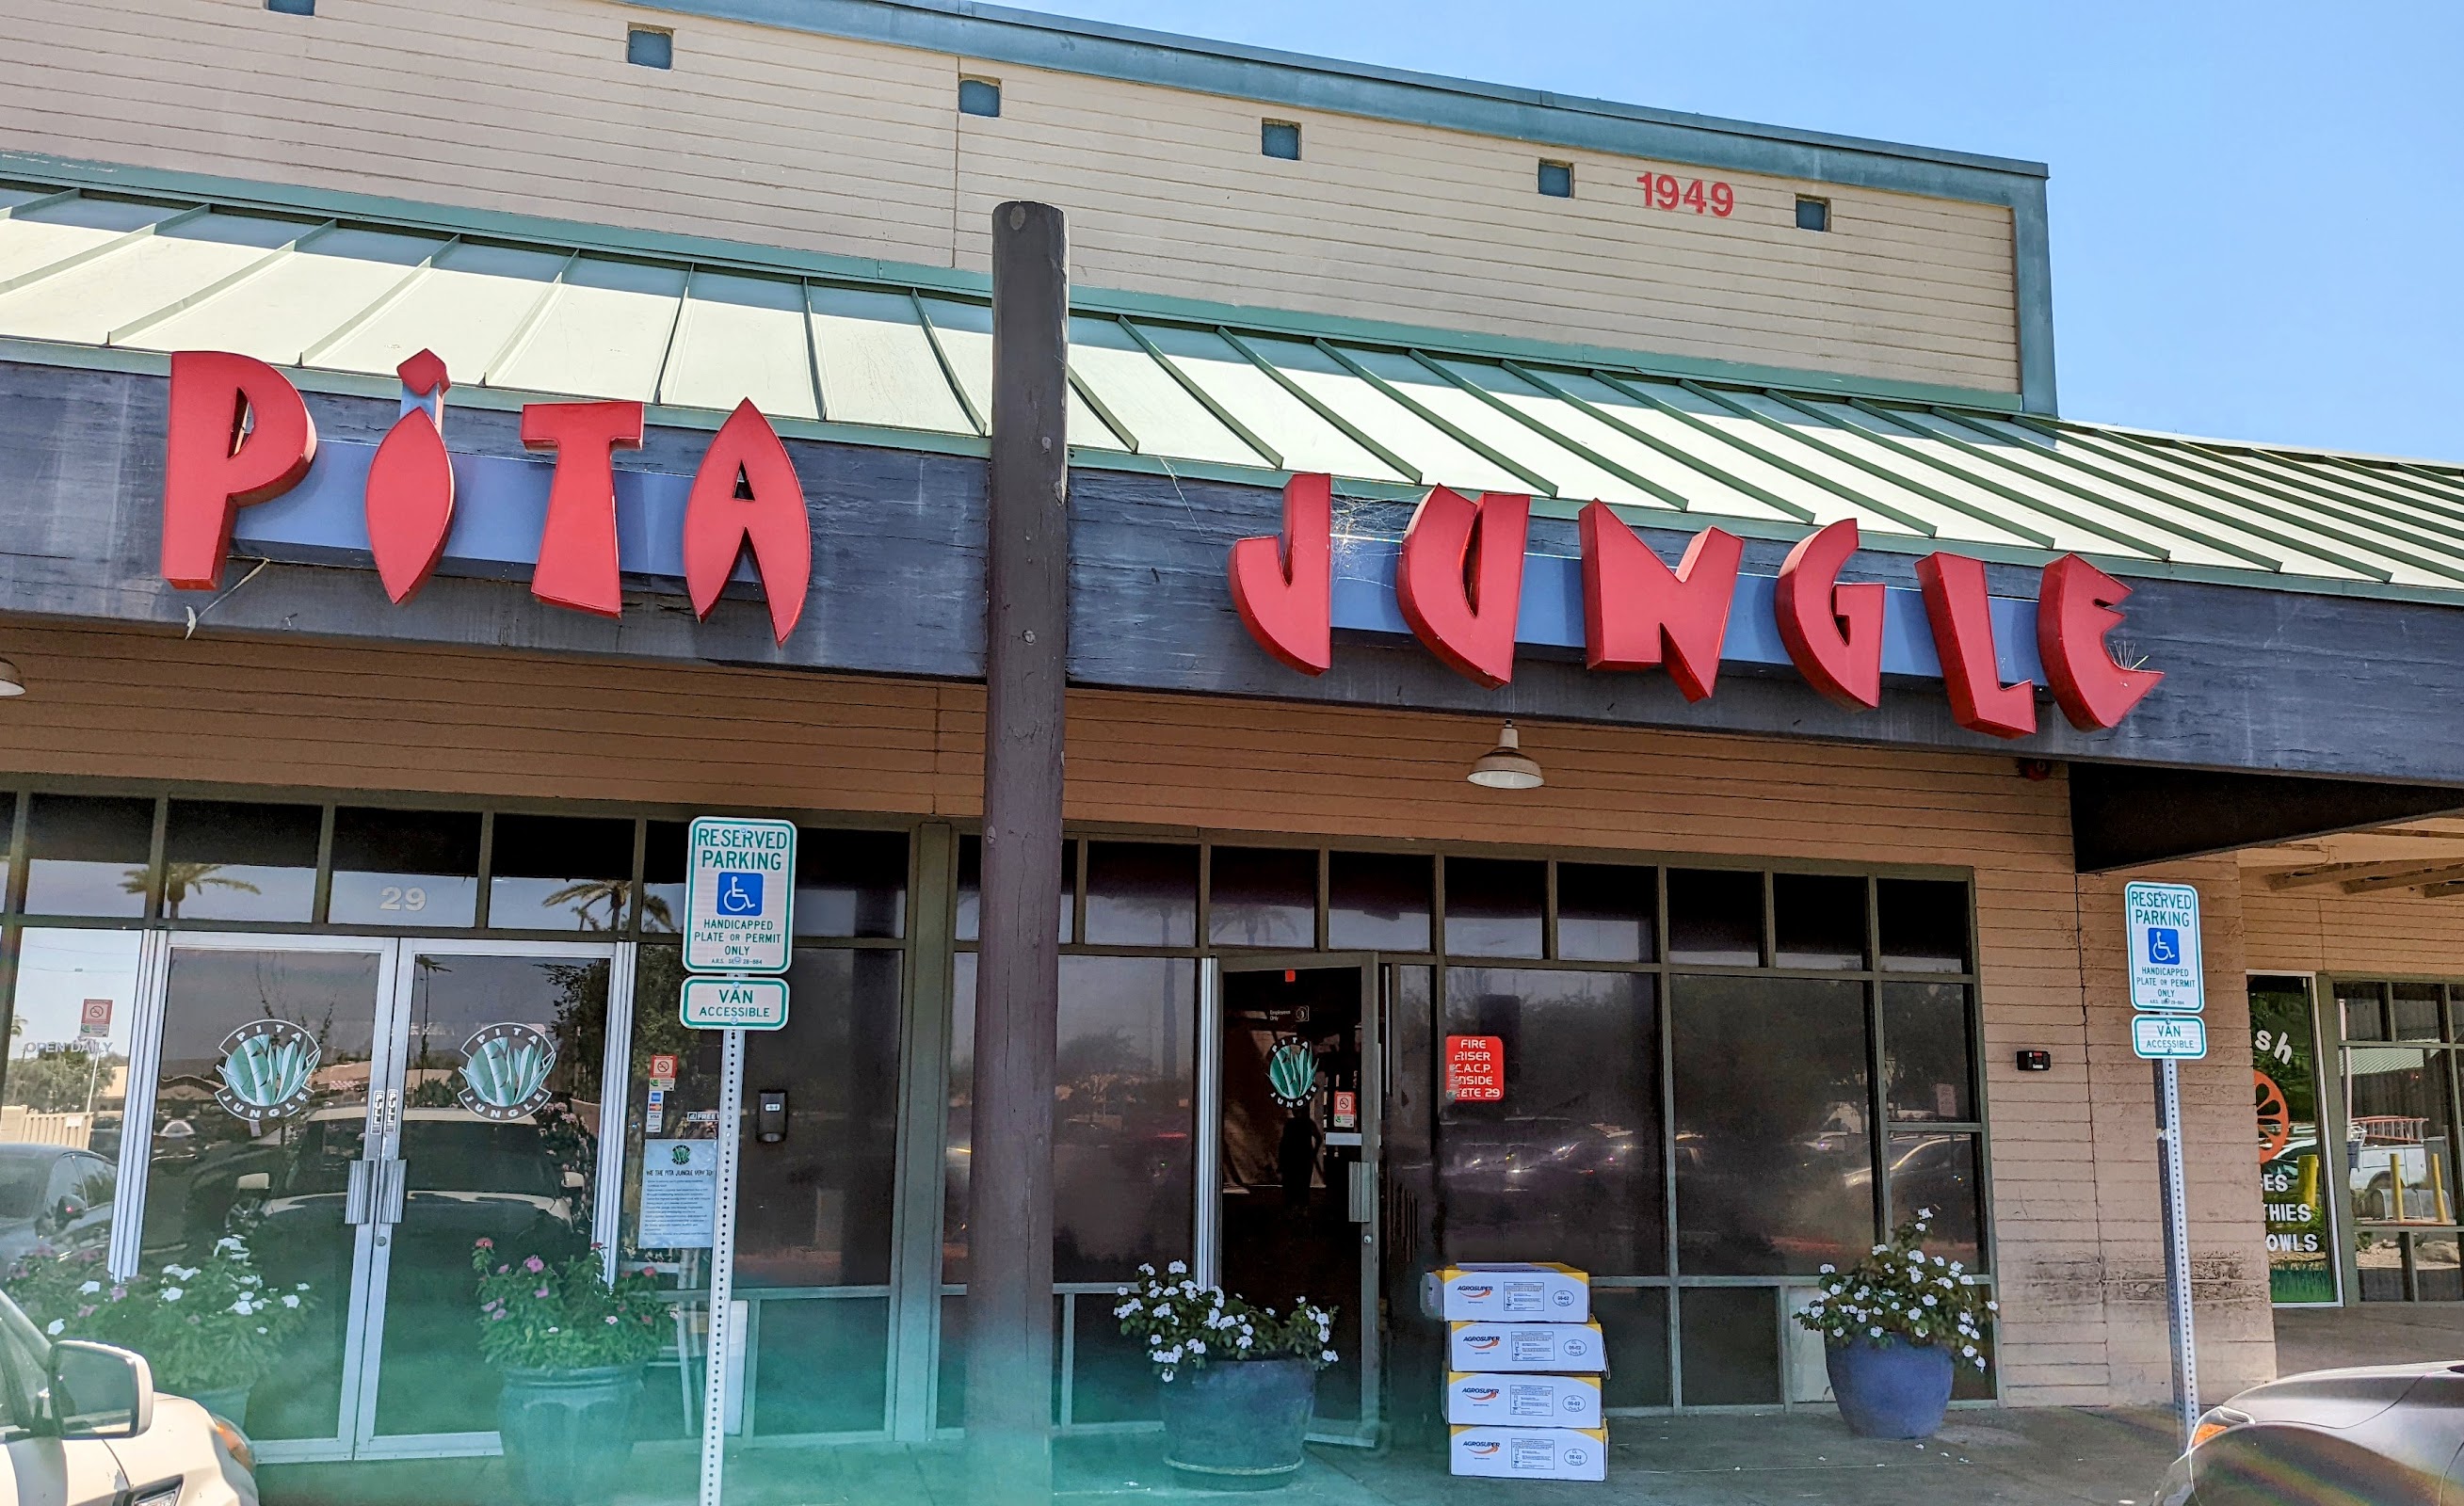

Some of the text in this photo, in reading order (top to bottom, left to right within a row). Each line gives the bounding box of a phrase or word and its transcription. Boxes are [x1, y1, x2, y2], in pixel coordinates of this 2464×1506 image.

[1636, 171, 1733, 217] 1949
[1228, 472, 2165, 739] JUNGLE
[698, 828, 787, 849] RESERVED
[701, 850, 781, 871] PARKING
[379, 886, 427, 911] 29
[2132, 891, 2192, 909] RESERVED
[703, 919, 773, 931] HANDICAPPED
[2135, 910, 2190, 927] PARKING
[694, 932, 724, 942] PLATE
[745, 934, 781, 944] PERMIT
[724, 945, 750, 956] ONLY
[2141, 967, 2189, 977] HANDICAPPED
[2136, 977, 2157, 985] PLATE
[2170, 979, 2196, 988] PERMIT
[719, 989, 753, 1004] VAN
[2157, 988, 2175, 998] ONLY
[699, 1006, 770, 1017] ACCESSIBLE
[236, 1024, 301, 1042] PITA
[476, 1027, 538, 1045] PITA
[2157, 1025, 2181, 1037] VAN
[25, 1042, 66, 1052] OPEN
[1271, 1037, 1309, 1053] PITA
[1460, 1039, 1486, 1049] FIRE
[2146, 1039, 2194, 1049] ACCESSIBLE
[1270, 1085, 1316, 1108] JUNGLE
[1485, 1088, 1500, 1097] 29
[222, 1092, 307, 1118] JUNGLE
[373, 1094, 382, 1124] PULL
[387, 1093, 396, 1123] PULL
[465, 1093, 543, 1118] JUNGLE
